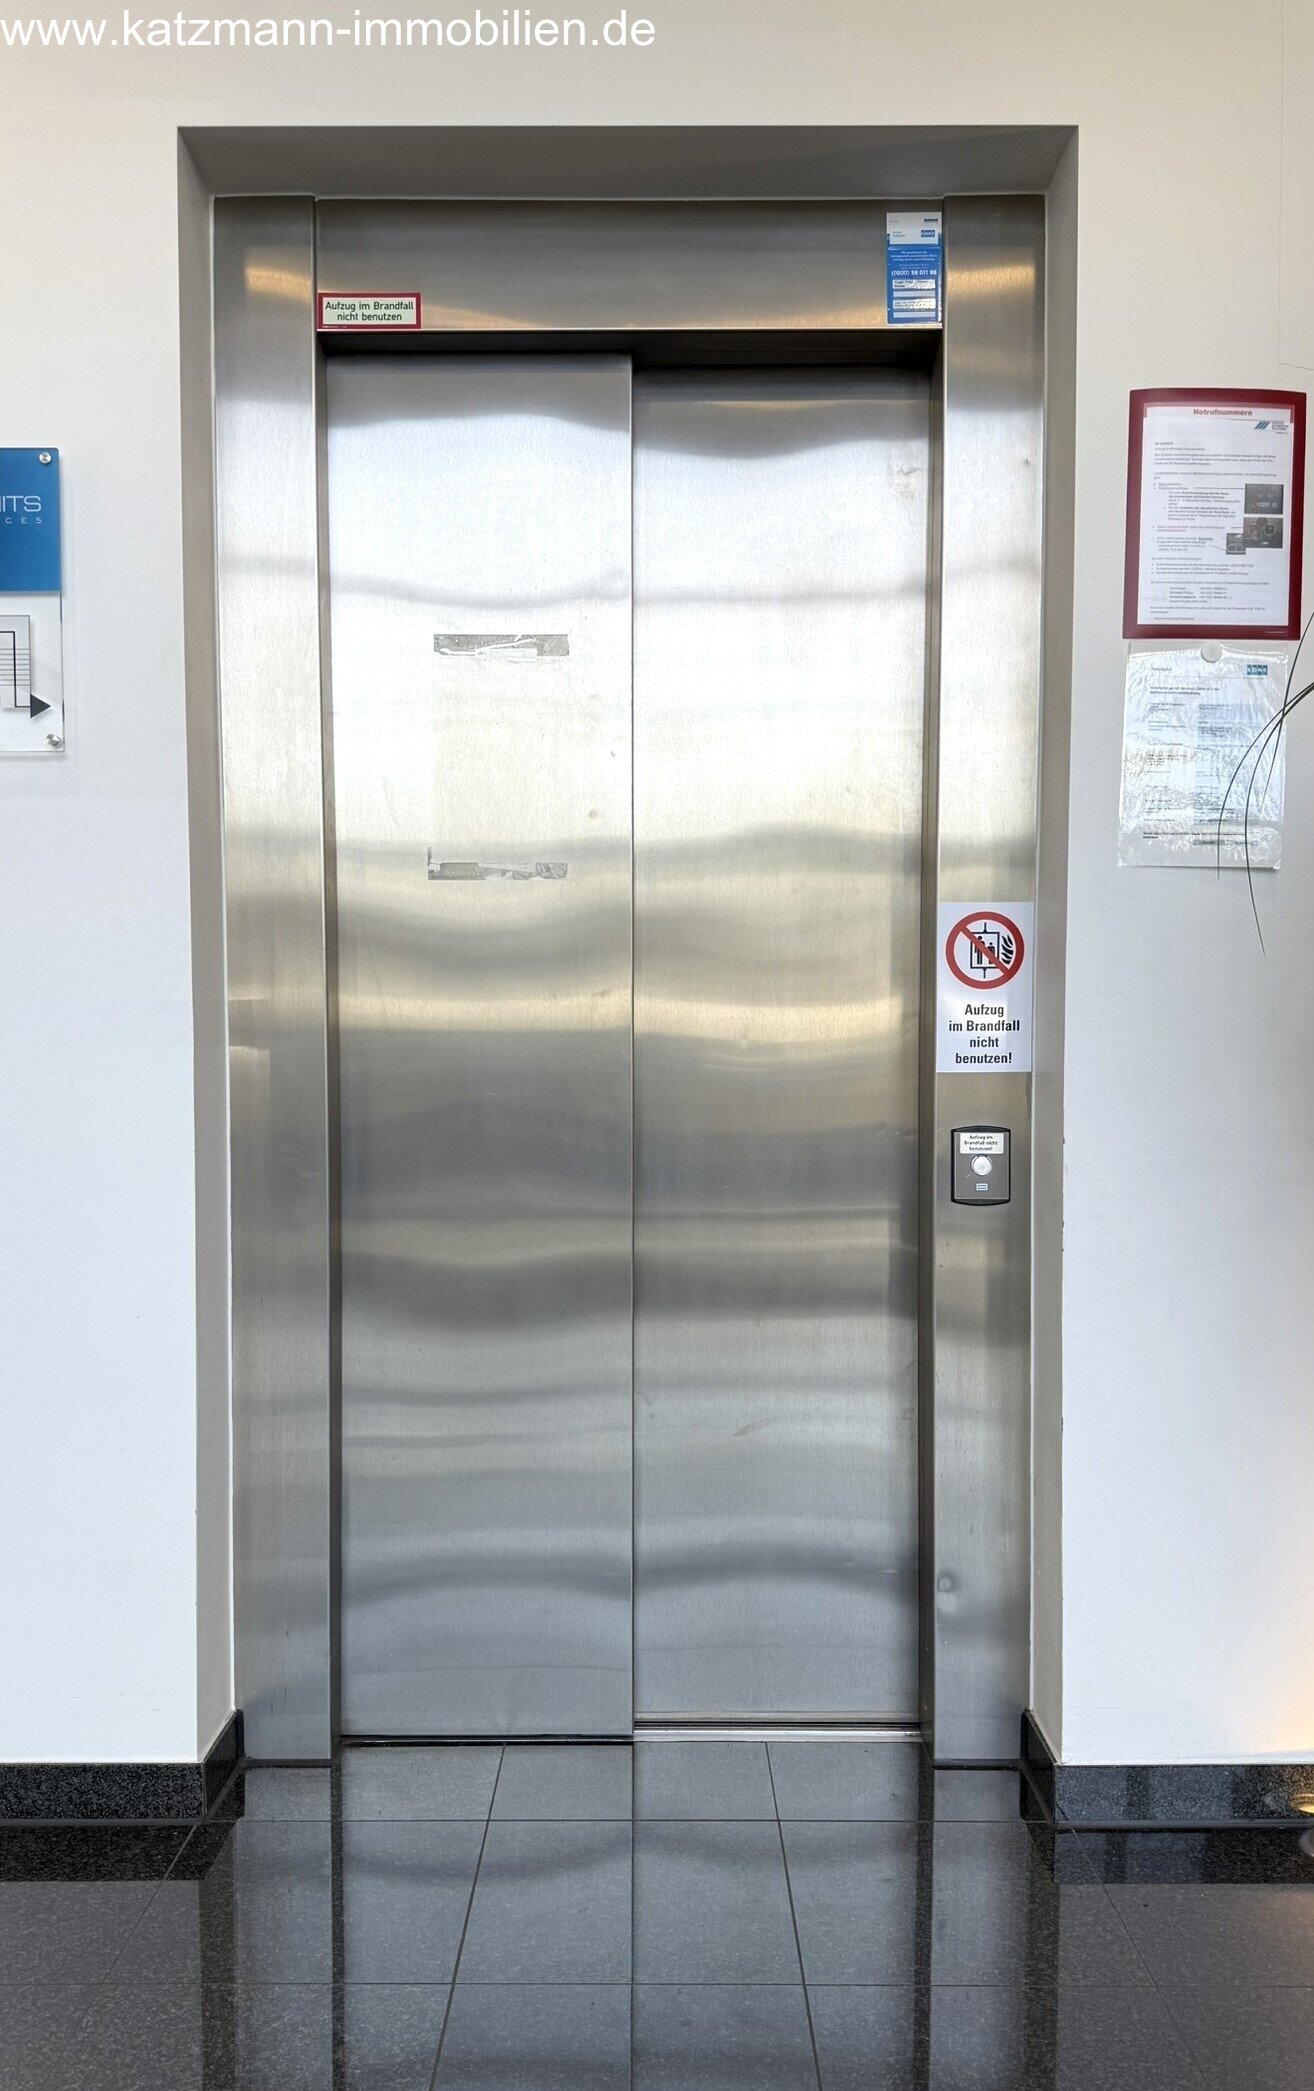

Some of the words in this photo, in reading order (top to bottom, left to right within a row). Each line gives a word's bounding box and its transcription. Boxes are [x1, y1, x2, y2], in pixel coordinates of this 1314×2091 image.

[325, 301, 356, 312] Aufzug
[359, 301, 370, 310] im
[373, 301, 414, 310] Brandfall
[337, 312, 359, 321] nicht
[361, 312, 402, 321] benutzen
[1193, 408, 1253, 417] Notrufnummern
[0, 495, 42, 512] ITS
[964, 1004, 1004, 1018] Aufzug
[948, 1020, 963, 1032] im
[966, 1019, 1020, 1032] Brandfall
[969, 1036, 999, 1048] nicht
[955, 1052, 1012, 1064] benutzen!
